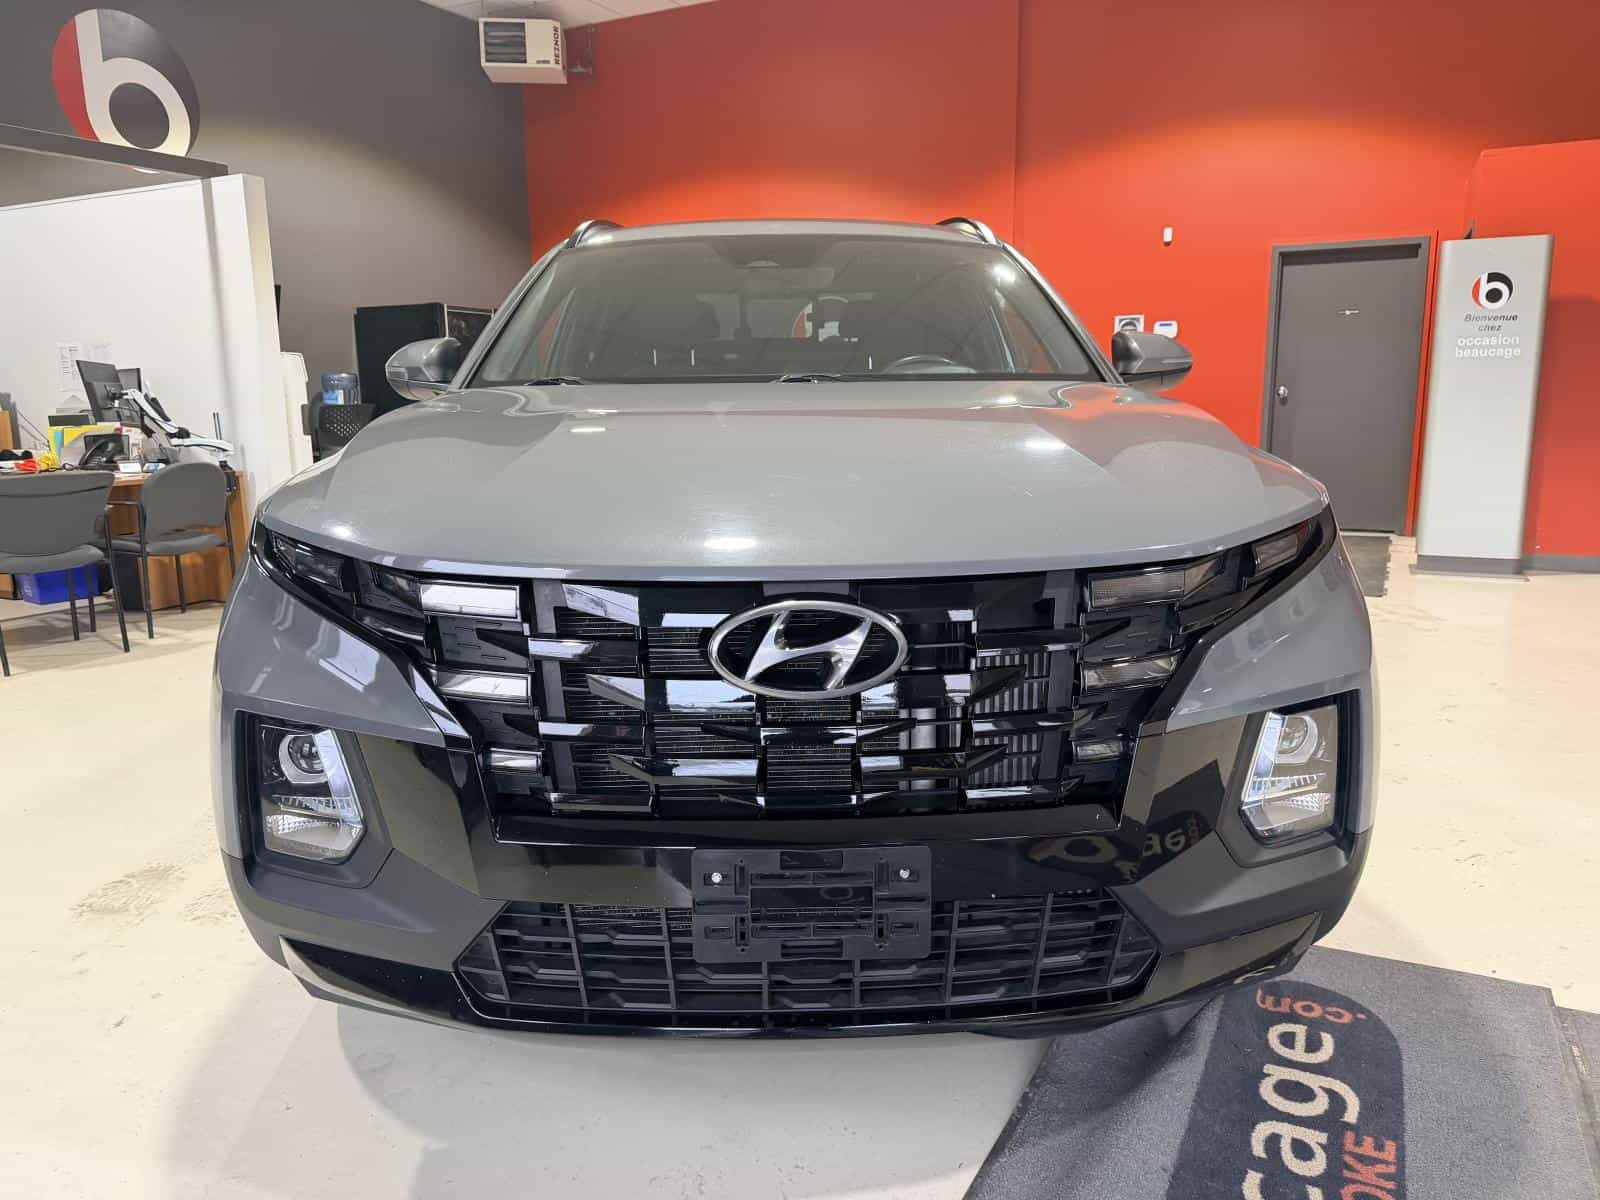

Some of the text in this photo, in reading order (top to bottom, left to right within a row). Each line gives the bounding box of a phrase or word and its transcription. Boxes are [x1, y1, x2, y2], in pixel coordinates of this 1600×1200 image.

[551, 25, 561, 65] REZNOR
[1464, 313, 1519, 322] Bienvenue
[1478, 324, 1503, 332] chez
[1457, 333, 1520, 346] occasion
[1455, 346, 1521, 359] beaucage
